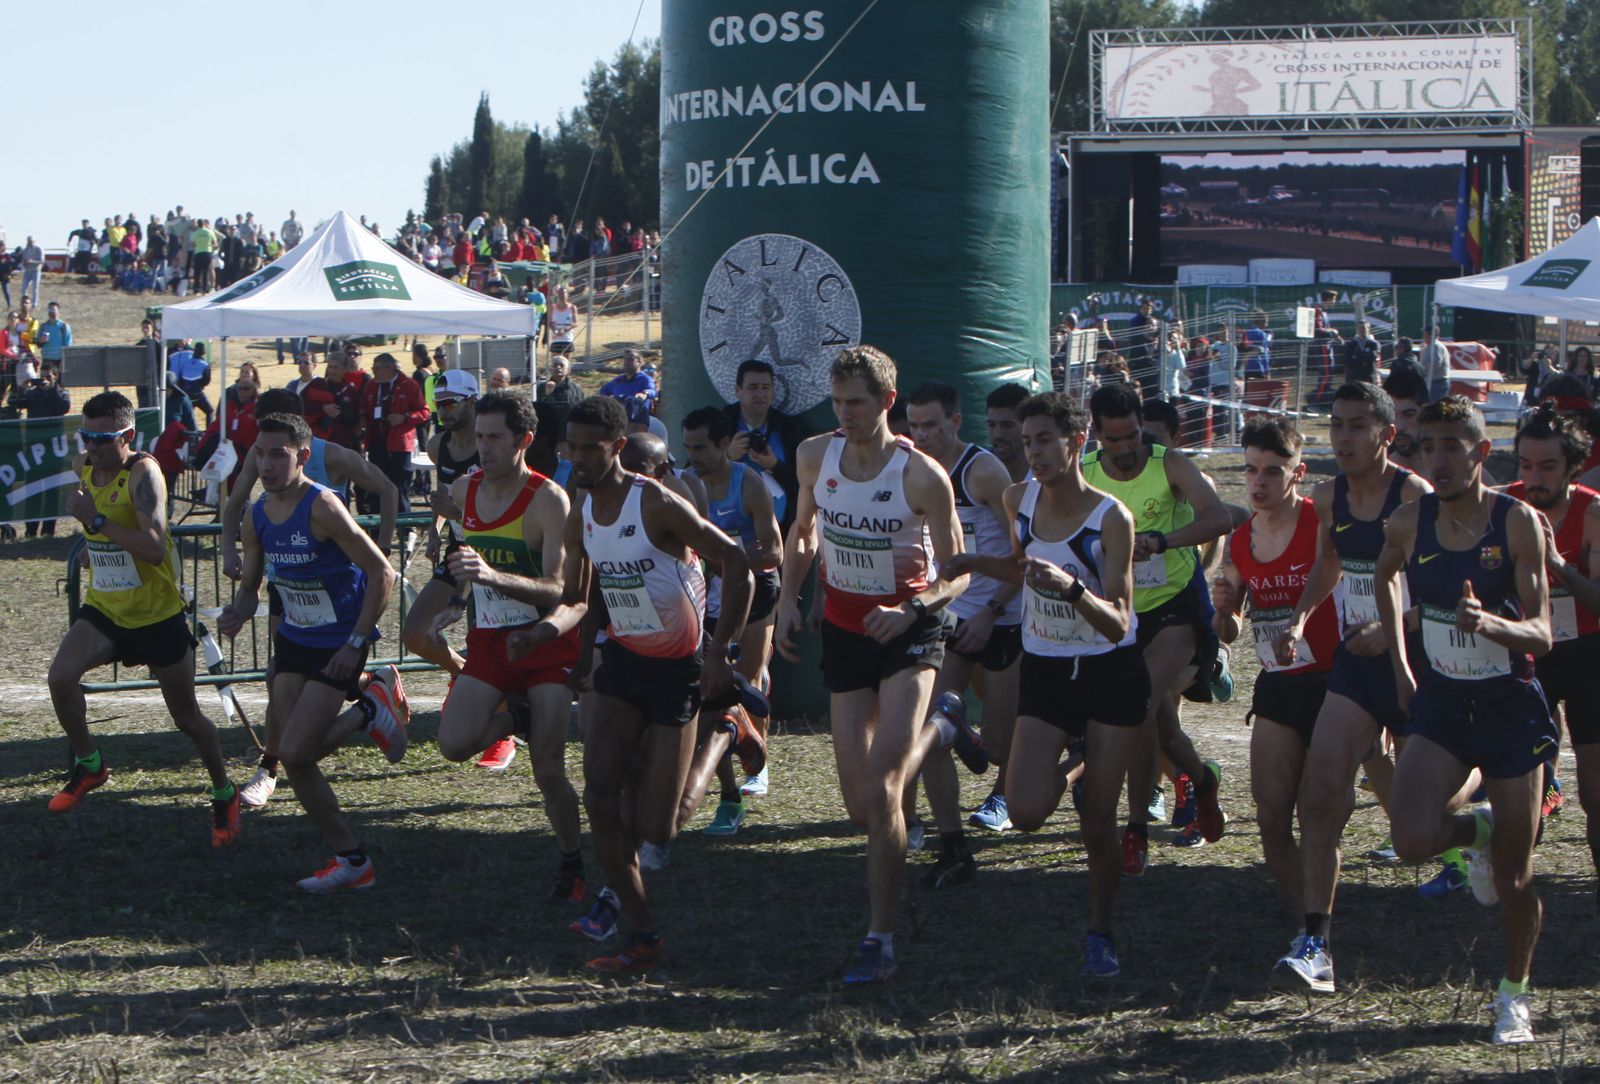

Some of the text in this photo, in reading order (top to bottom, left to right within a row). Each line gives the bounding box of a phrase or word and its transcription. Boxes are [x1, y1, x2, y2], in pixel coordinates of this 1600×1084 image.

[708, 10, 825, 47] CROSS
[1273, 58, 1502, 74] CROSS INTERNACIONAL DE
[1353, 50, 1408, 59] CROSS
[1419, 48, 1503, 57] COUNTRY
[665, 80, 926, 126] INTERNACIONAL
[1275, 72, 1507, 113] ITÁLICA
[685, 147, 881, 191] DE ITÁLICA
[340, 283, 399, 293] SEVILLA
[705, 239, 851, 355] ITALICA
